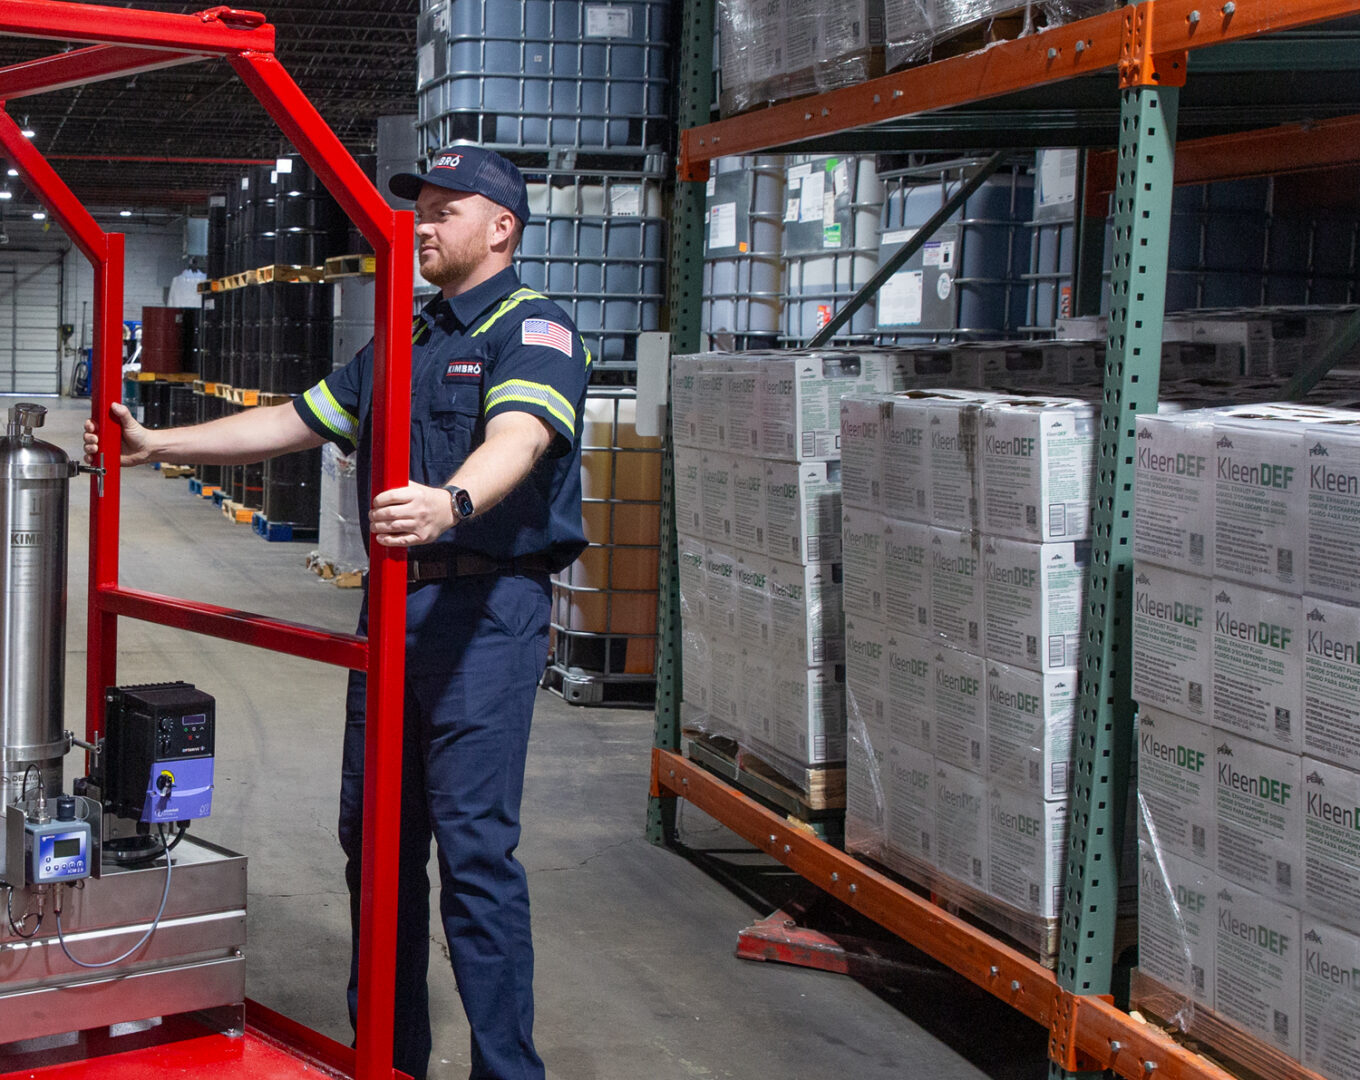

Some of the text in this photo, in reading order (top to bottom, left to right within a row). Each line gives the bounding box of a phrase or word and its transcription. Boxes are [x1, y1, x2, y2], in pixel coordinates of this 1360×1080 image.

[985, 437, 1035, 456] KleenDEF
[1138, 446, 1205, 476] KleenDEF
[1217, 455, 1293, 487] KleenDEF
[933, 551, 977, 576] KleenDEF
[986, 562, 1036, 587] KleenDEF
[1136, 590, 1202, 626] KleenDEF
[1216, 609, 1291, 648] KleenDEF
[889, 651, 928, 678] KleenDEF
[936, 667, 979, 696] KleenDEF
[989, 684, 1039, 714] KleenDEF
[1141, 731, 1204, 770] KleenDEF
[1218, 760, 1290, 803] KleenDEF
[991, 804, 1040, 837] KleenDEF
[1218, 905, 1288, 954] KleenDEF
